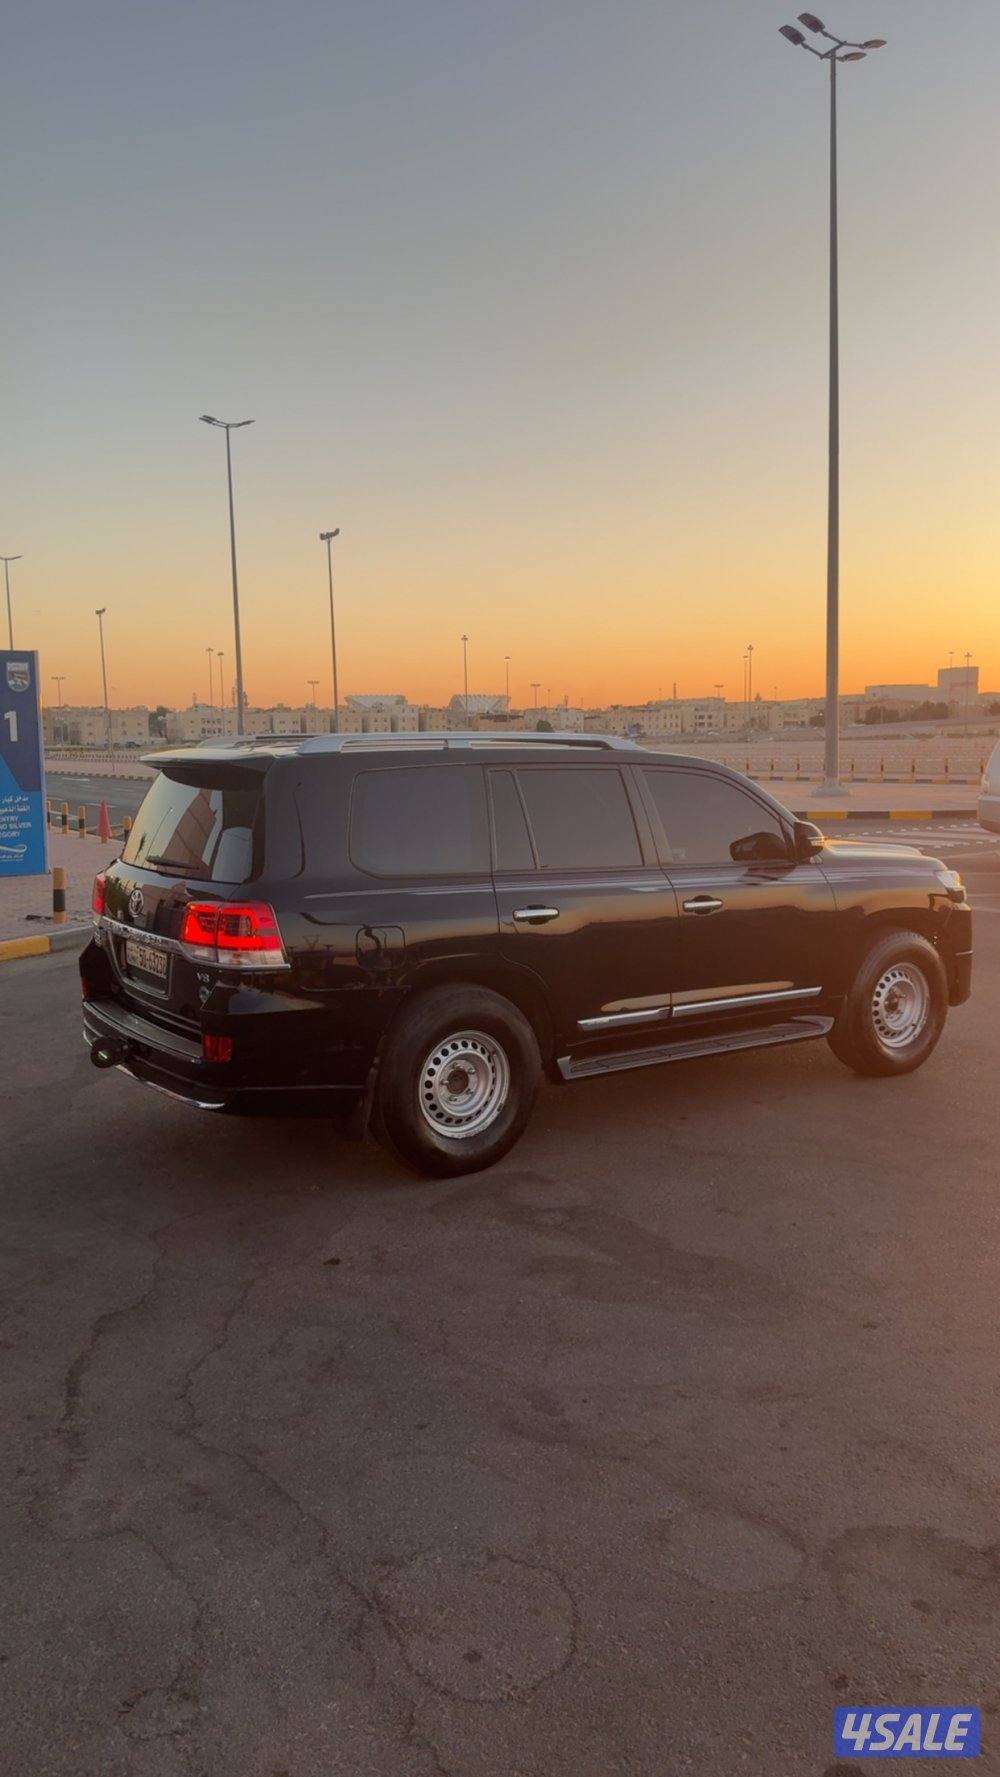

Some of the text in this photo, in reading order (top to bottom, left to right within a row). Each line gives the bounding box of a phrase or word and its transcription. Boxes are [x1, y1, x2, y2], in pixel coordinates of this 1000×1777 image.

[4, 710, 18, 742] 1
[9, 822, 32, 830] SILVER
[196, 972, 210, 983] V8
